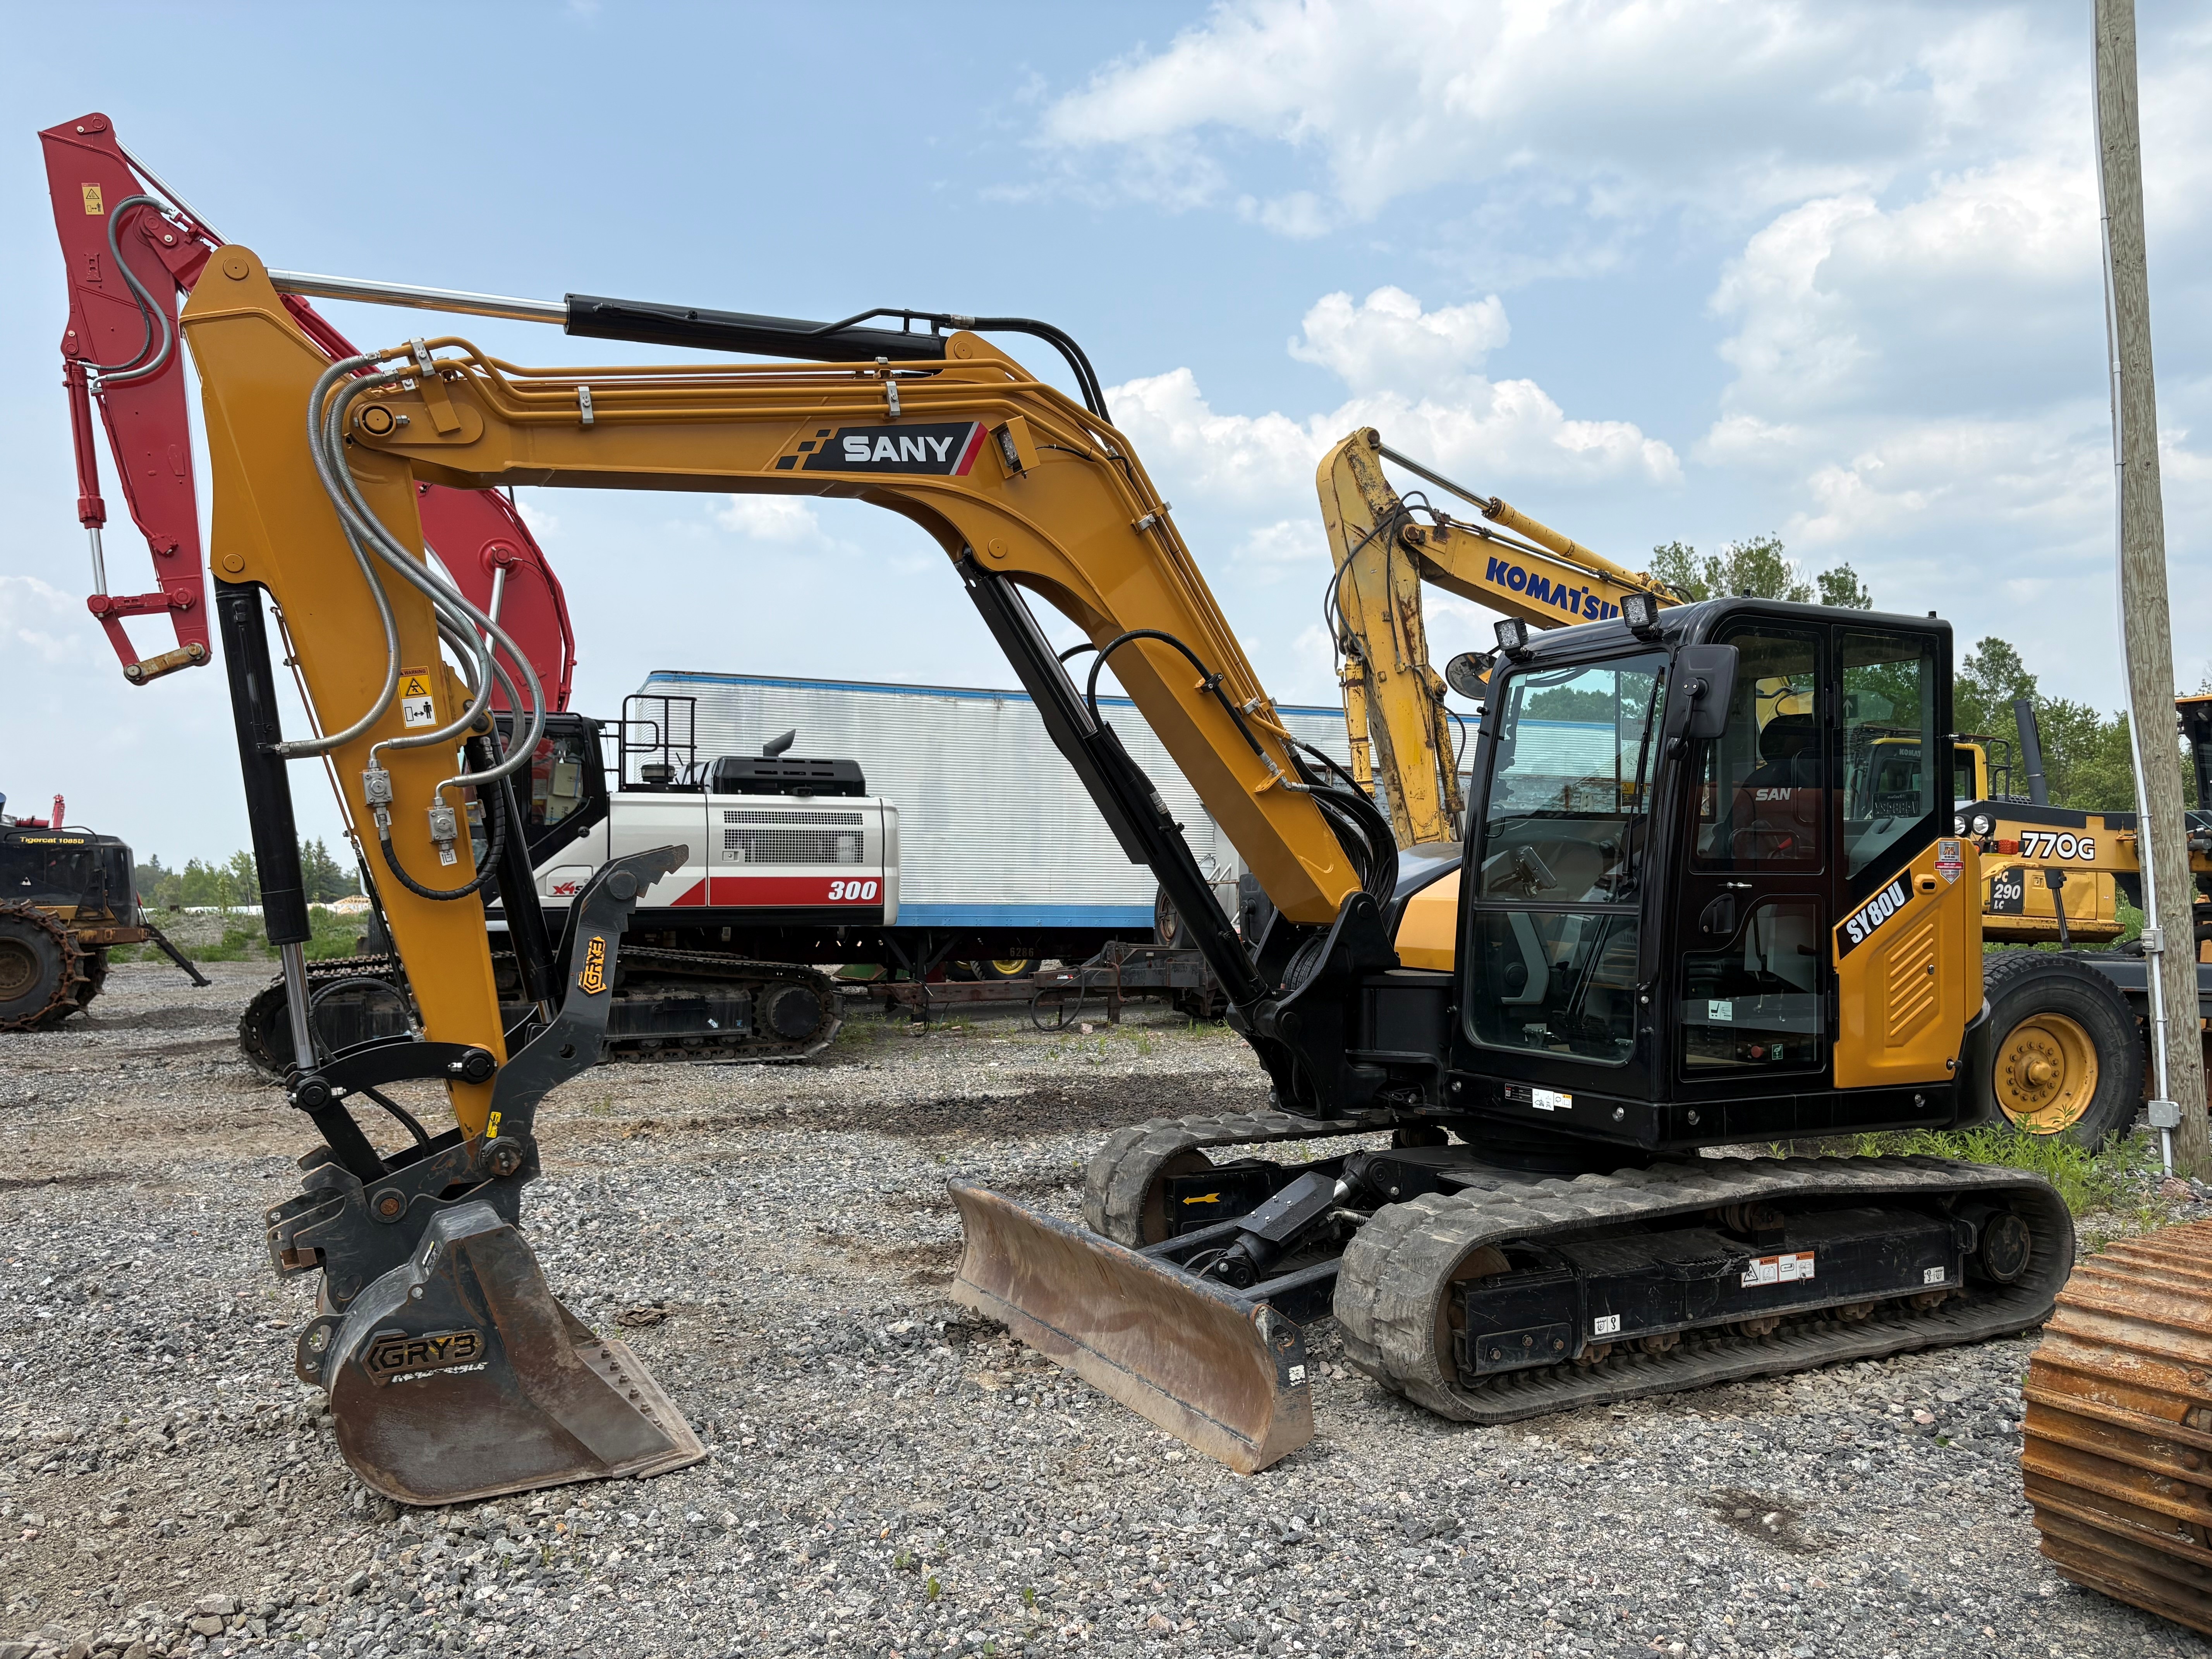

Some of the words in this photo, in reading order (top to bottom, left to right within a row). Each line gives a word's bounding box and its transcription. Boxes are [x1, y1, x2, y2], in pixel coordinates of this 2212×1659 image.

[843, 436, 953, 462] SANY
[1485, 556, 1619, 620] KOMATSU
[1755, 787, 1802, 801] SAN
[2021, 831, 2095, 861] 770G
[828, 881, 877, 900] 300
[1993, 884, 2021, 900] 290
[1846, 880, 1905, 944] SY80U
[1993, 900, 2004, 910] LC
[1010, 947, 1034, 957] 6286
